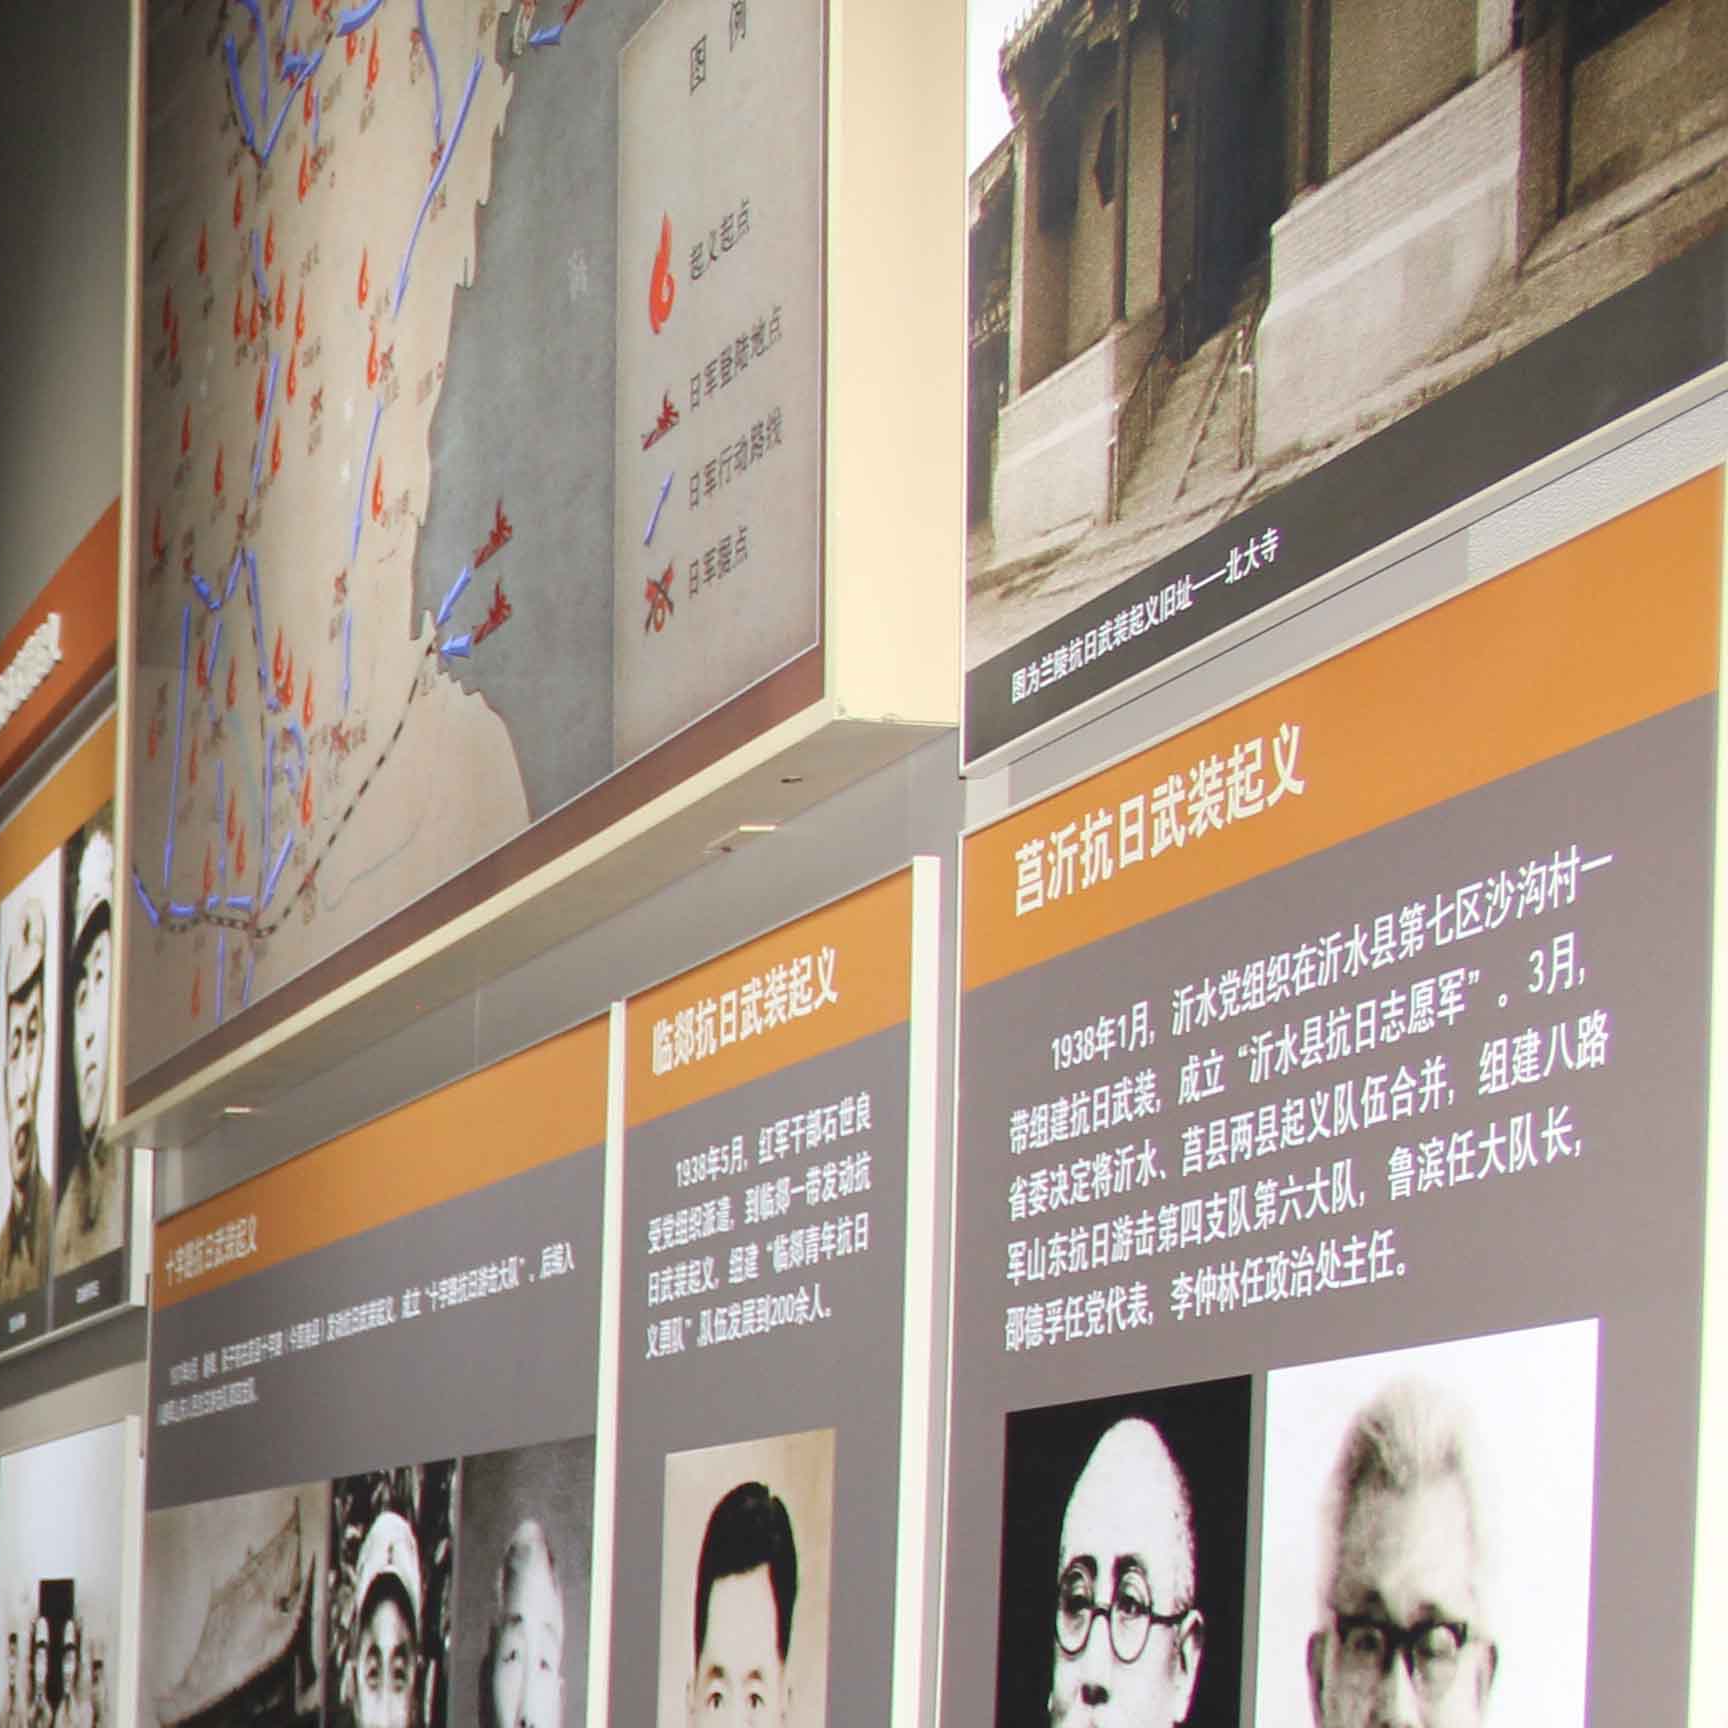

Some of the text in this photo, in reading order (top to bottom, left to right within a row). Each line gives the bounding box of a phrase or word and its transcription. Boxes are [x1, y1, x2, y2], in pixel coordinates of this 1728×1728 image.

[1014, 722, 1305, 917] 莒沂抗日武装起义
[652, 945, 839, 1077] 临郯抗日武装起义
